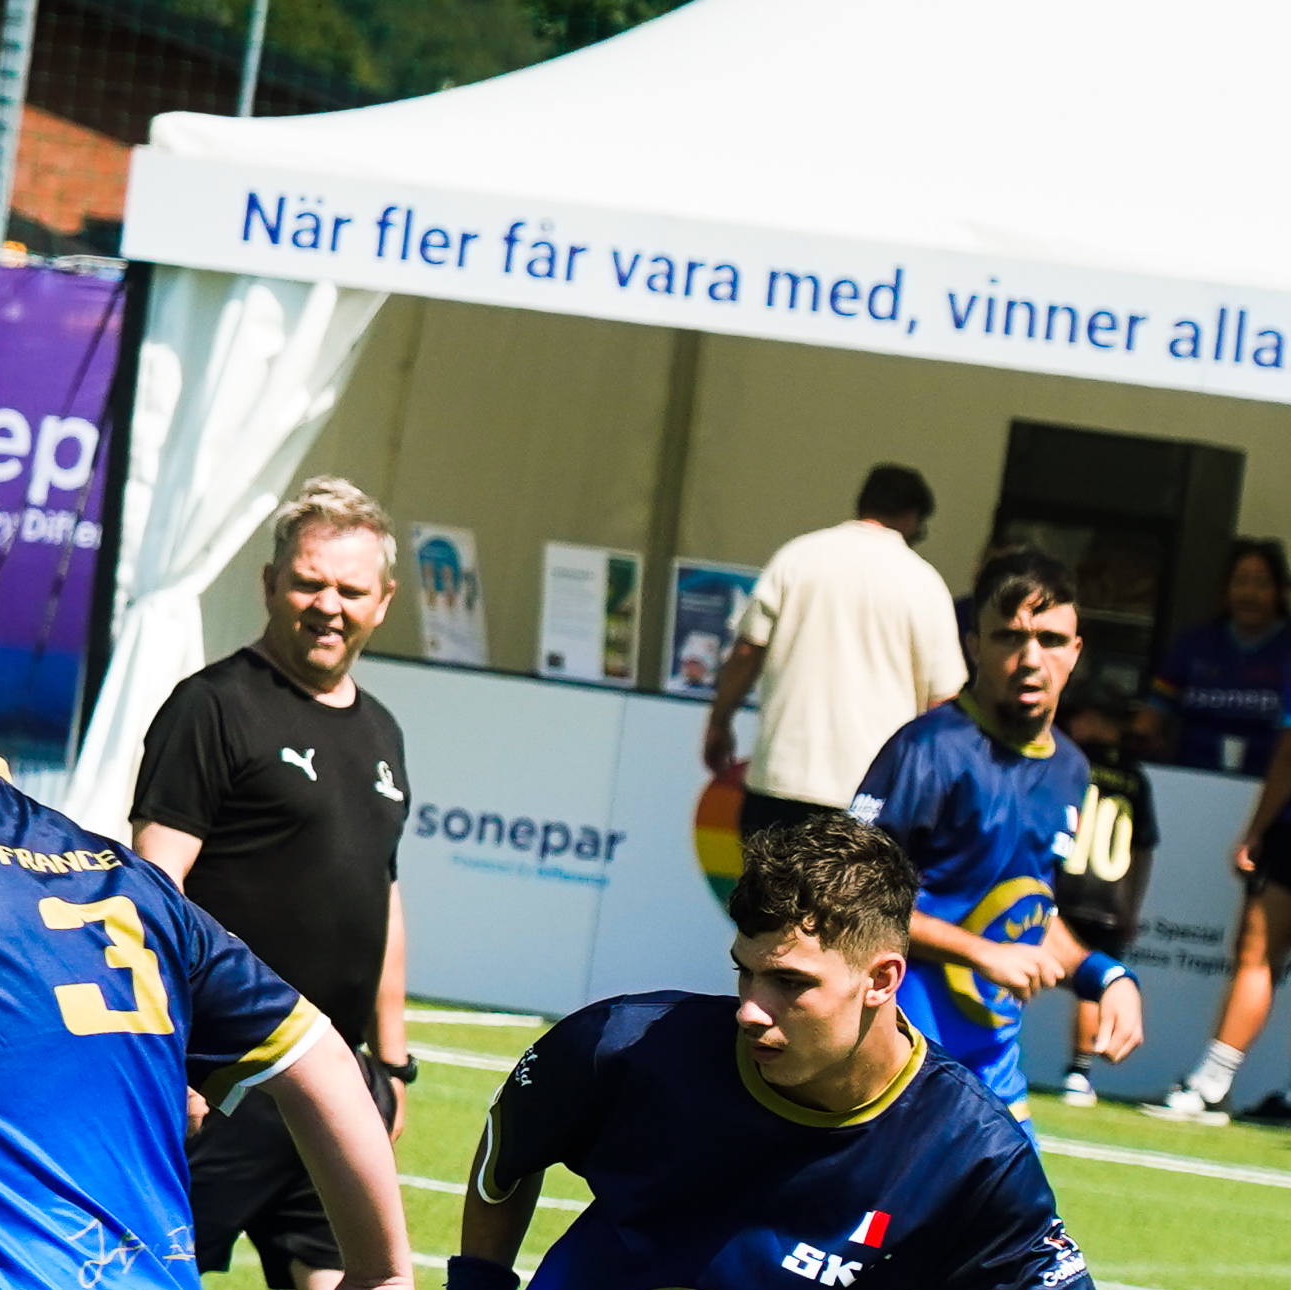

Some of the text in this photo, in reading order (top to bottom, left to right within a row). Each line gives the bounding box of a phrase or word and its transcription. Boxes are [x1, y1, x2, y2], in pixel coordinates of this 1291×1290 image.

[241, 191, 1285, 369] När fler får vara med, vinner alla
[416, 802, 627, 864] sonepar
[38, 895, 176, 1036] 3
[781, 1242, 865, 1288] SK
